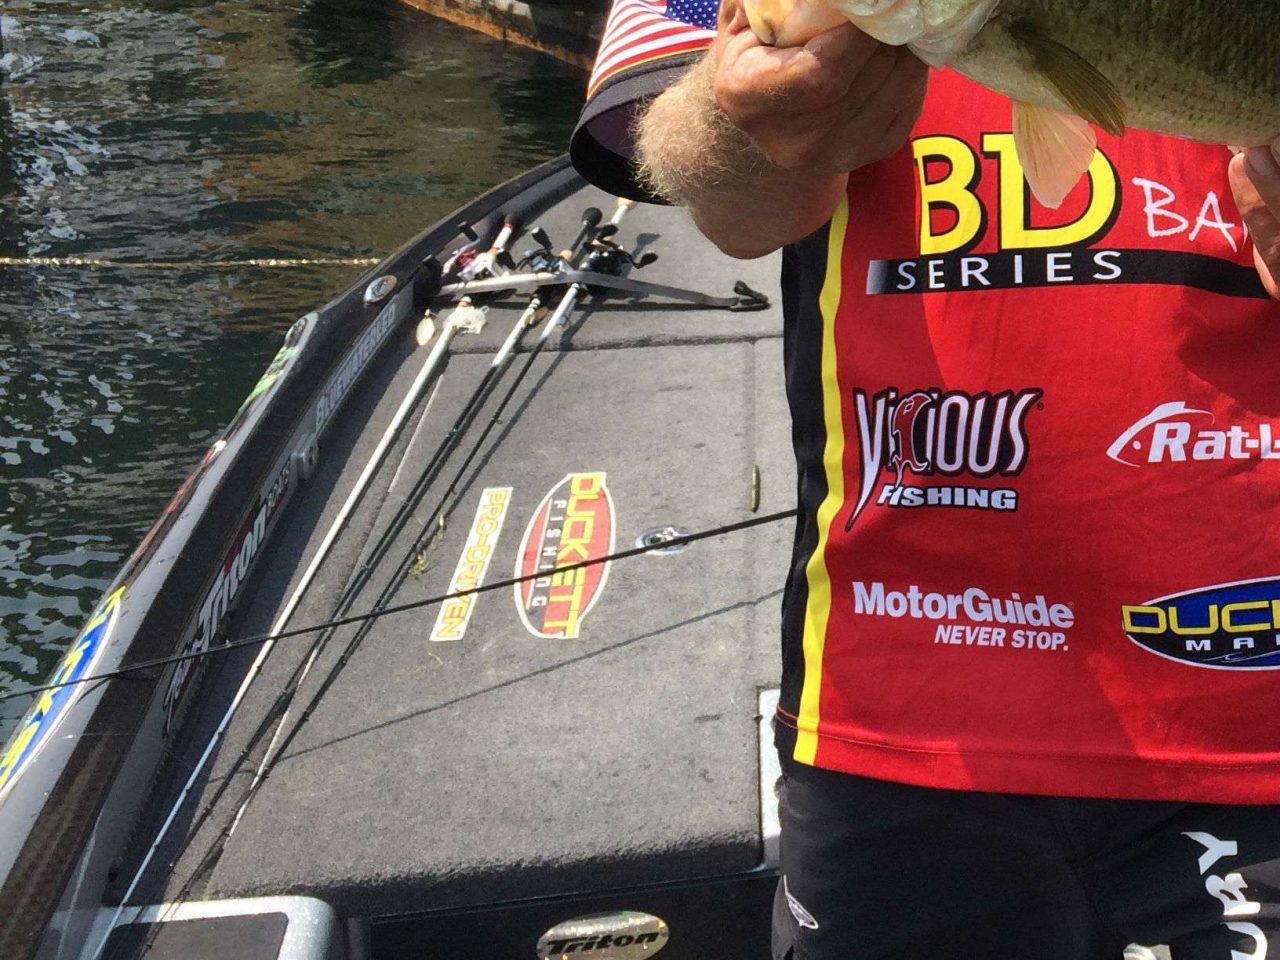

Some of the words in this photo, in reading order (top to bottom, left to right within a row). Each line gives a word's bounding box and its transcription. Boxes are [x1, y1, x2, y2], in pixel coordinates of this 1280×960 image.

[912, 133, 1122, 257] BD
[896, 250, 1123, 290] SERIES
[877, 484, 1019, 511] FISHING
[436, 491, 506, 639] PRO-DRIVEN
[532, 499, 567, 607] FISHING
[543, 473, 601, 638] DUCKETT
[852, 581, 1075, 629] MotorGuide
[934, 625, 1007, 647] NEVER
[1011, 629, 1069, 651] STOP.
[546, 931, 661, 955] Triton
